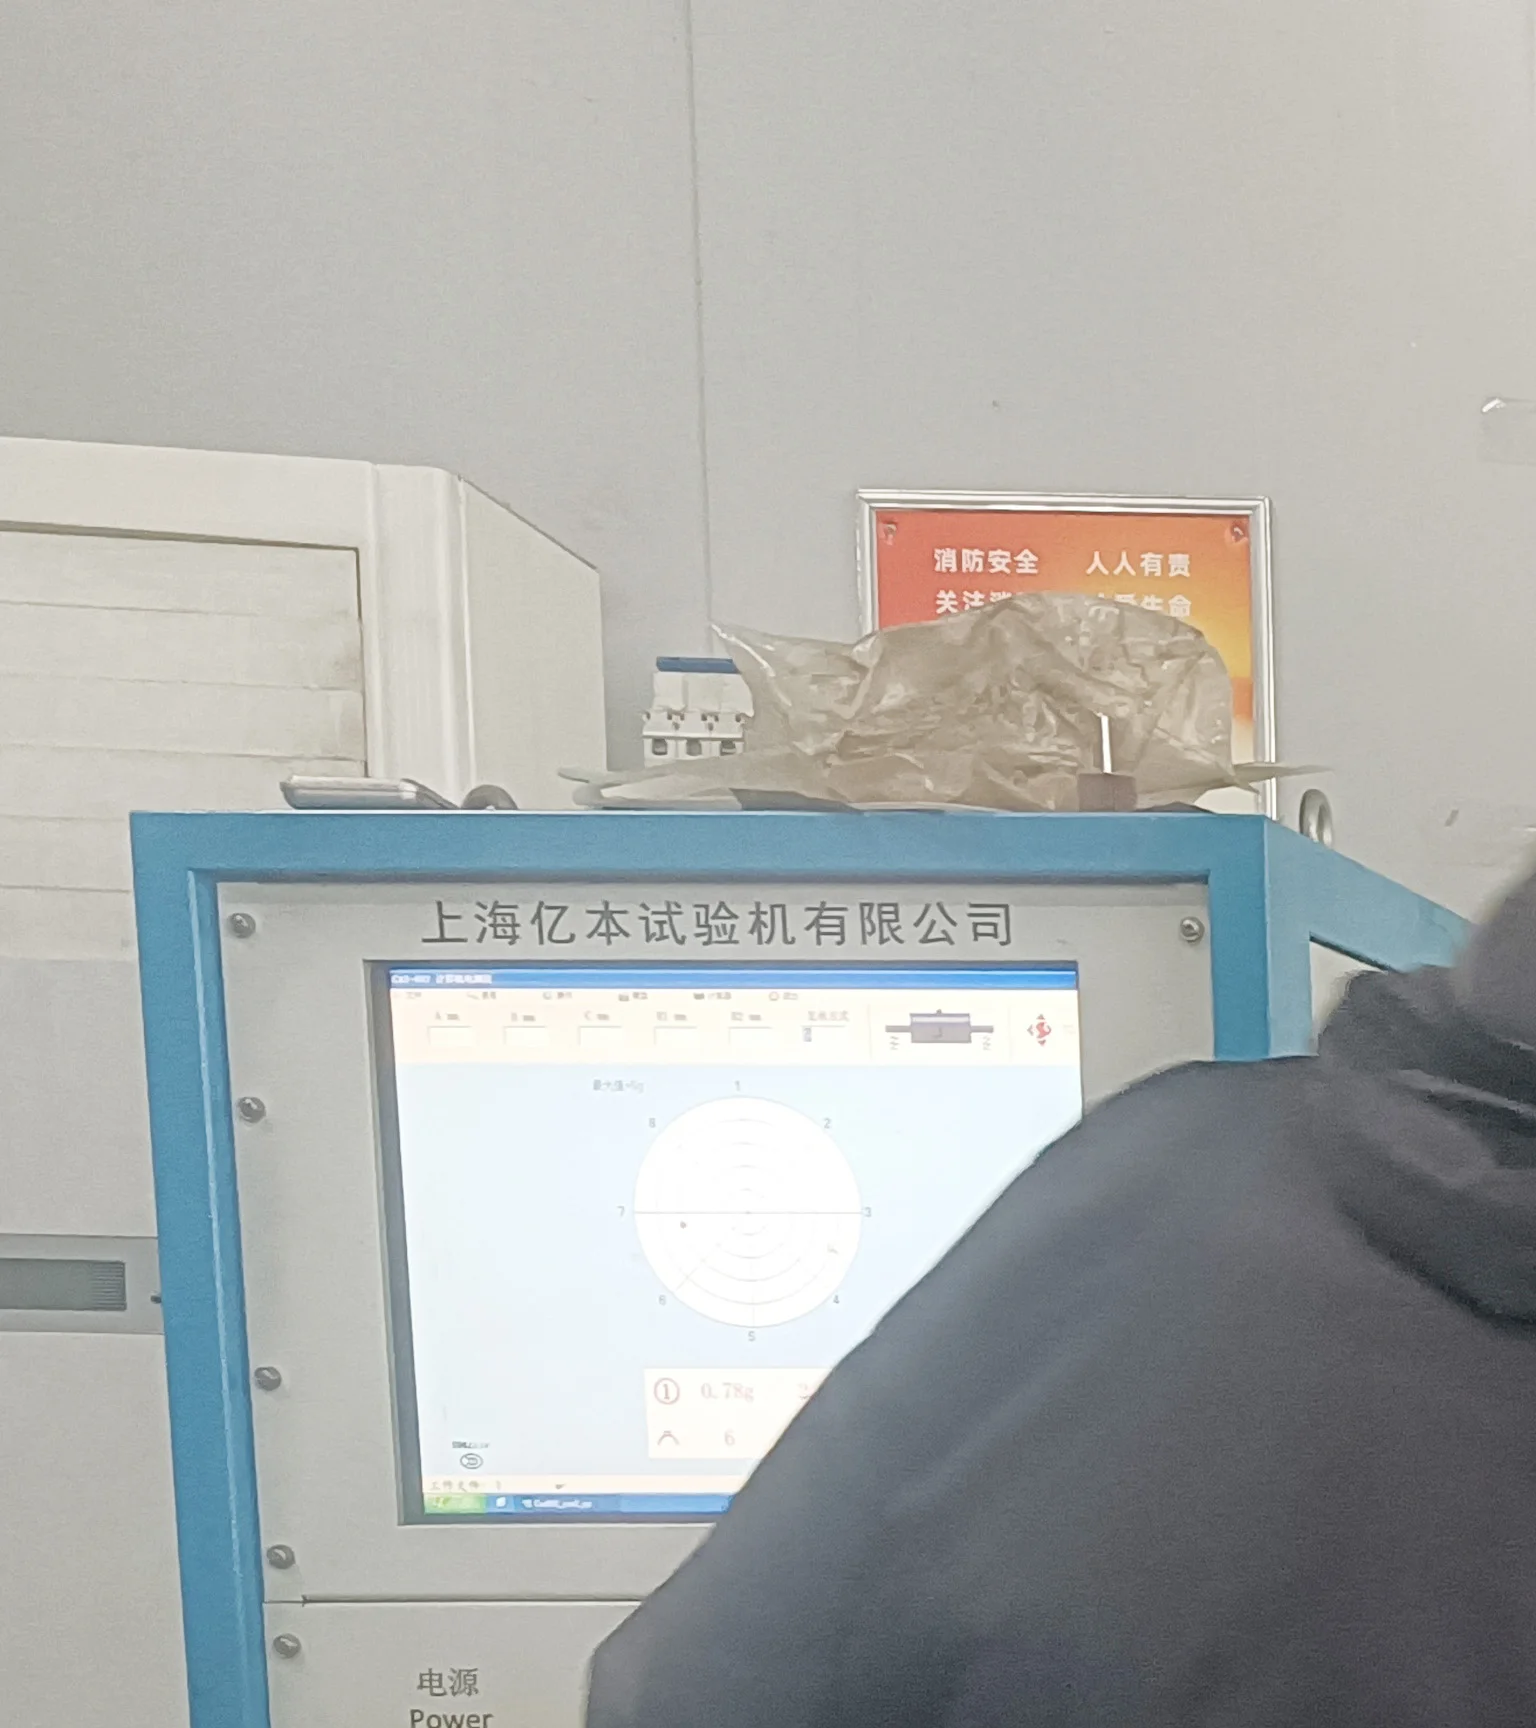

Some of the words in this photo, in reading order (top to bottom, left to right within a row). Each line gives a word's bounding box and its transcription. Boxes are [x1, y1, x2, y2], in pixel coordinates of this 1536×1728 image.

[933, 548, 1039, 575] 消防安全
[1085, 551, 1191, 578] 人人有责
[421, 900, 1012, 947] 上海亿本试验机有限公司
[416, 1667, 480, 1697] 电源
